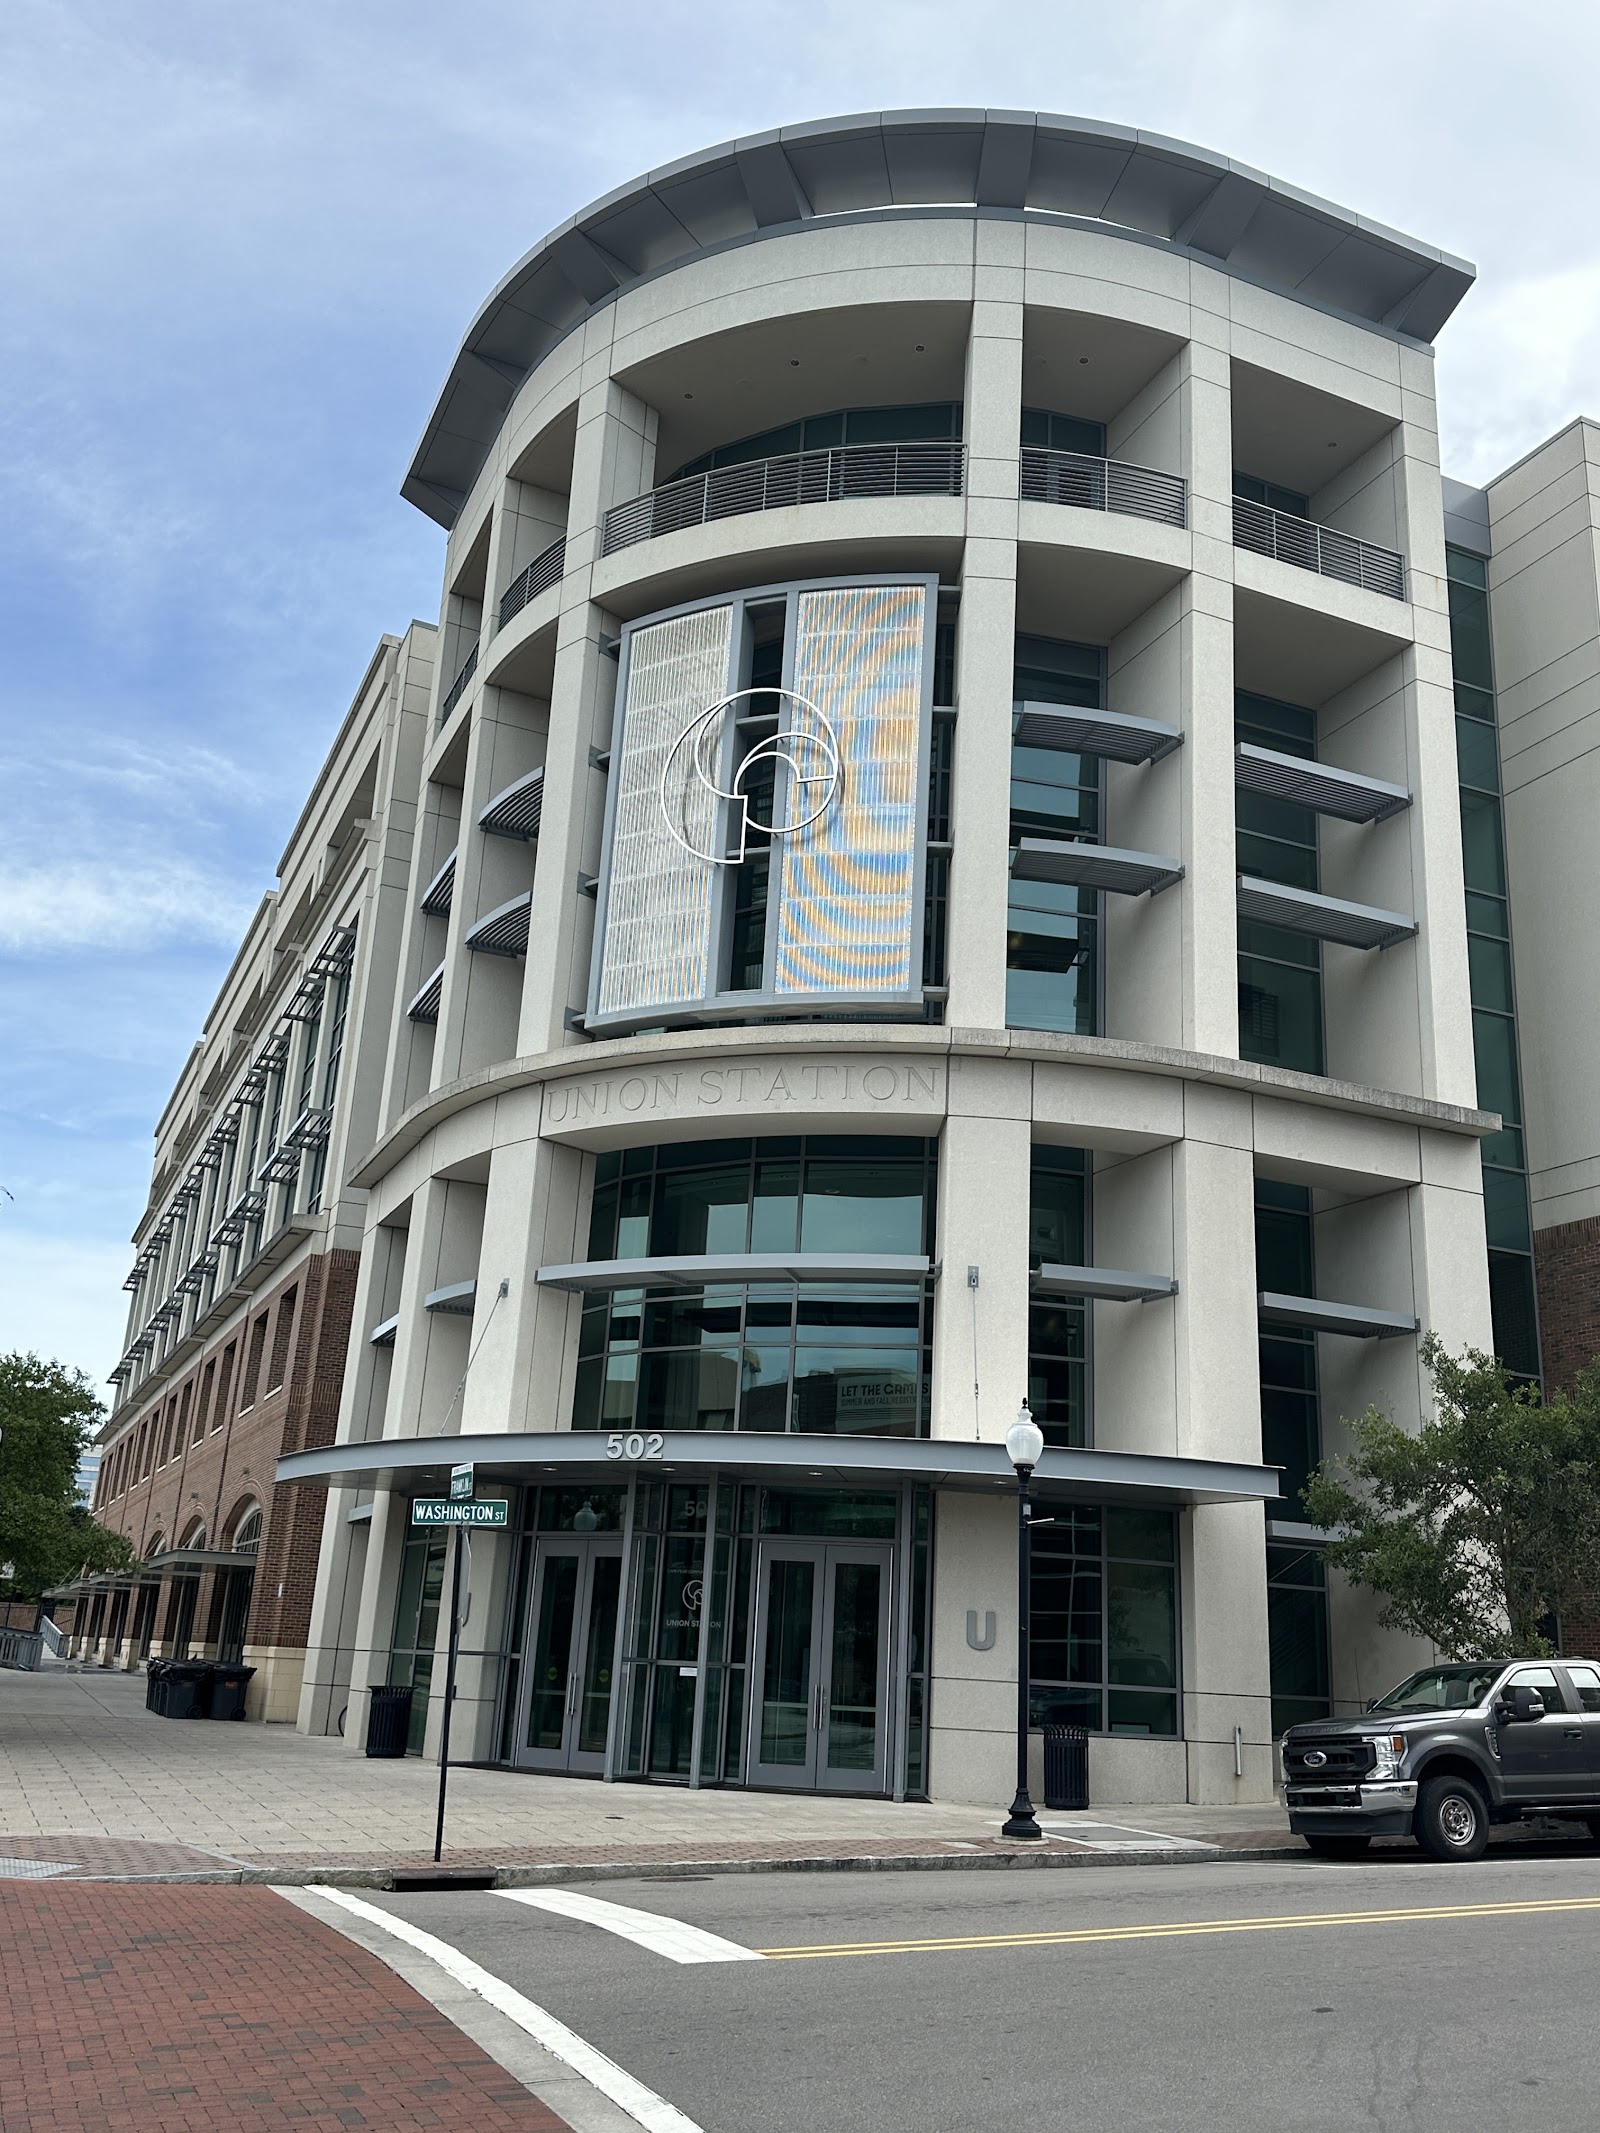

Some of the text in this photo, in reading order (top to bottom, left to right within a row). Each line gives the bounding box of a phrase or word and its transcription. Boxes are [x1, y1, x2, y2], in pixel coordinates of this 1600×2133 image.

[547, 1065, 941, 1123] UNION STATION
[841, 1385, 858, 1397] LET
[861, 1384, 881, 1396] THE
[606, 1433, 664, 1459] 502
[415, 1505, 504, 1520] WASHINGTON ST
[685, 1501, 708, 1517] 50
[666, 1619, 690, 1627] UNION
[967, 1610, 996, 1651] U
